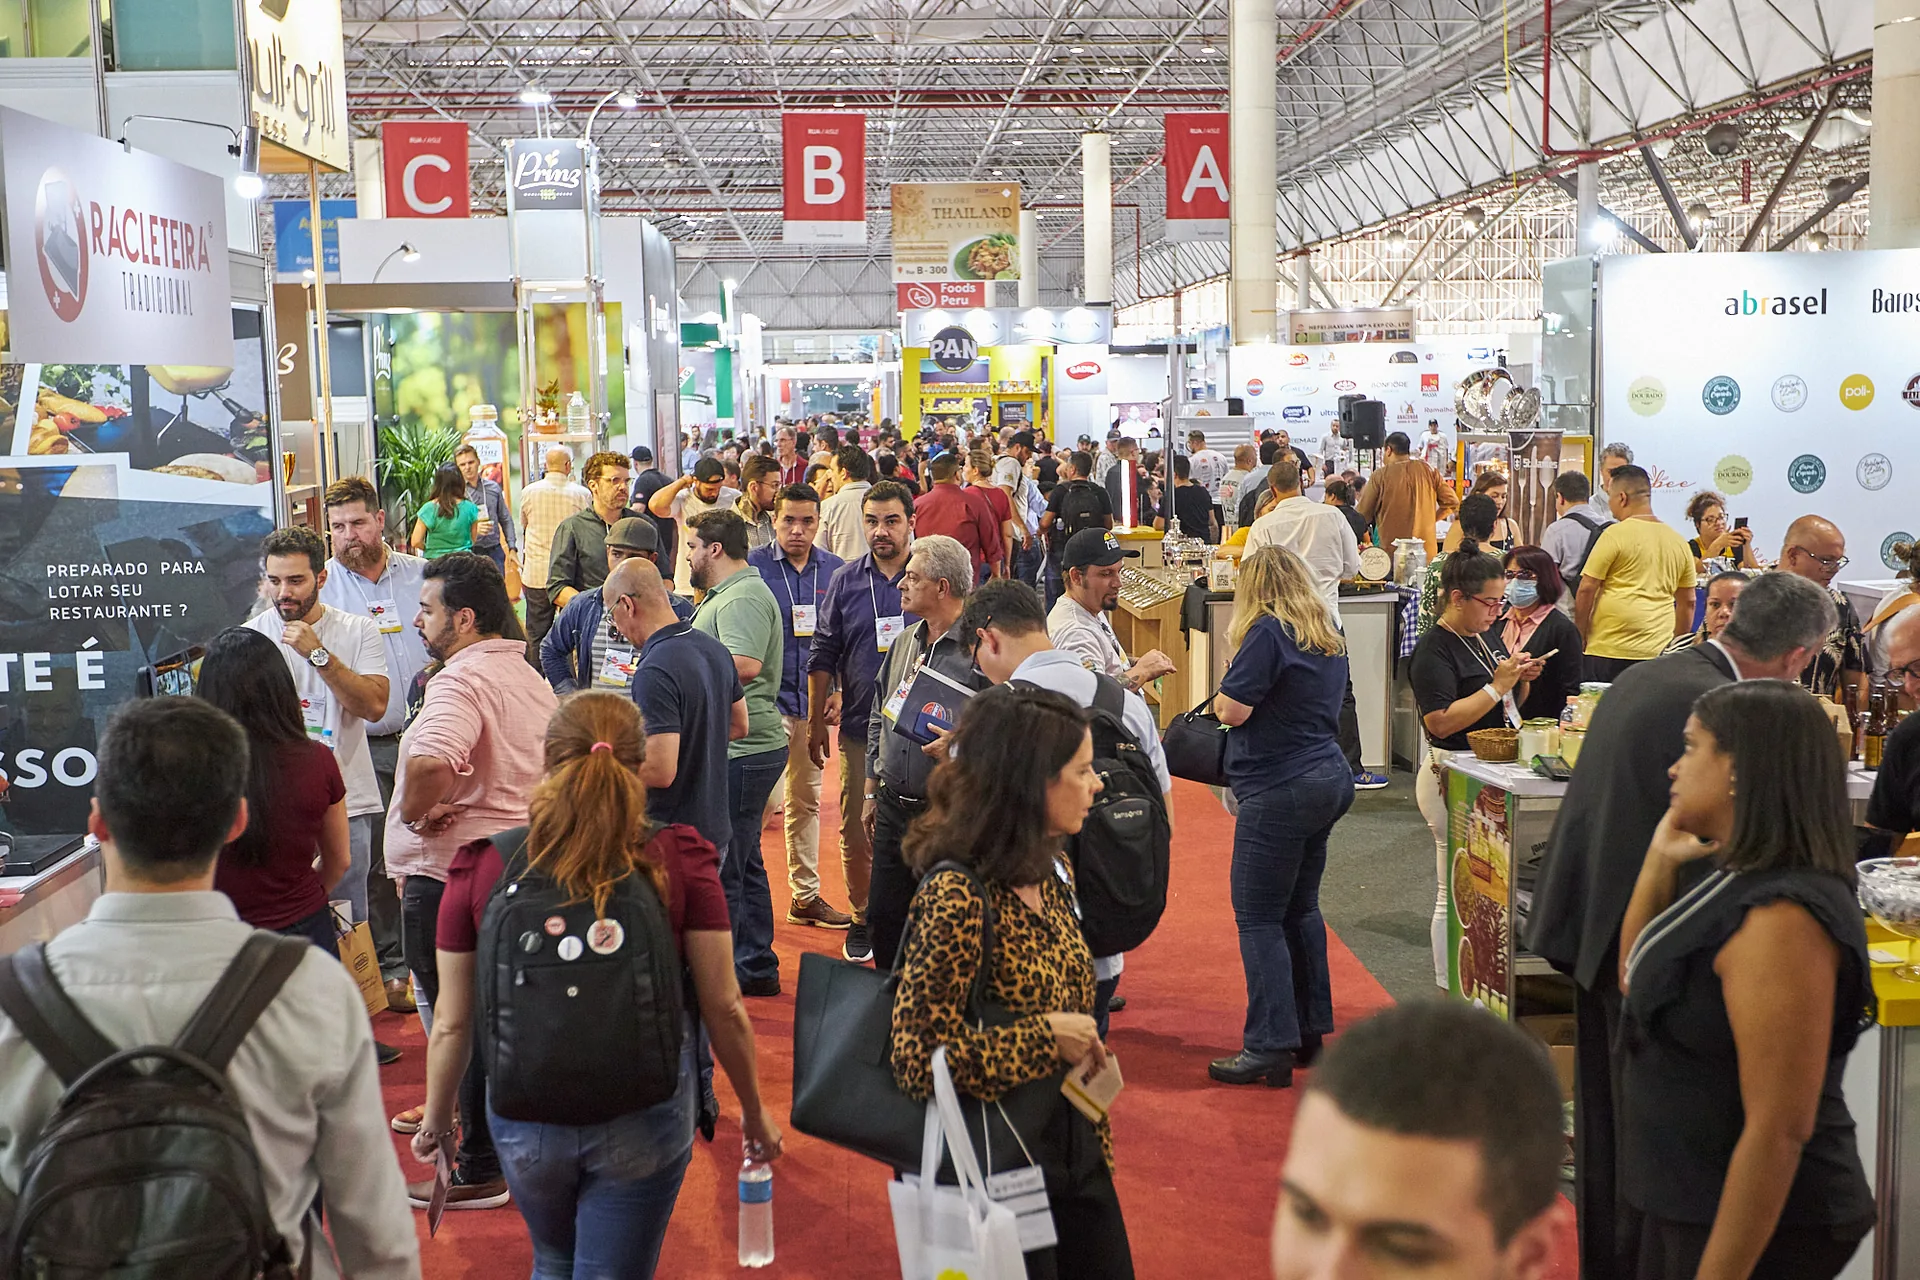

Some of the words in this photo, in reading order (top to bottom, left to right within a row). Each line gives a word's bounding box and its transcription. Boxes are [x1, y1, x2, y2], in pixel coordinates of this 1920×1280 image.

[403, 154, 452, 214] C
[514, 151, 581, 190] Prinz
[803, 145, 846, 205] B
[1182, 145, 1230, 203] A
[931, 207, 1012, 219] THAILAND
[90, 201, 211, 273] RACLETEIRA
[122, 271, 193, 316] TRADICIONAL
[940, 283, 976, 293] Foods
[941, 296, 969, 305] Peru
[1725, 288, 1827, 315] abrasel
[1845, 385, 1871, 400] poli-
[47, 562, 148, 577] PREPARADO
[160, 561, 206, 575] PARA
[48, 585, 103, 599] LOTAR
[110, 584, 142, 597] SEU
[50, 604, 172, 620] RESTAURANTE
[76, 636, 106, 690] É
[0, 747, 98, 788] SO
[1113, 809, 1143, 820] Samsonite
